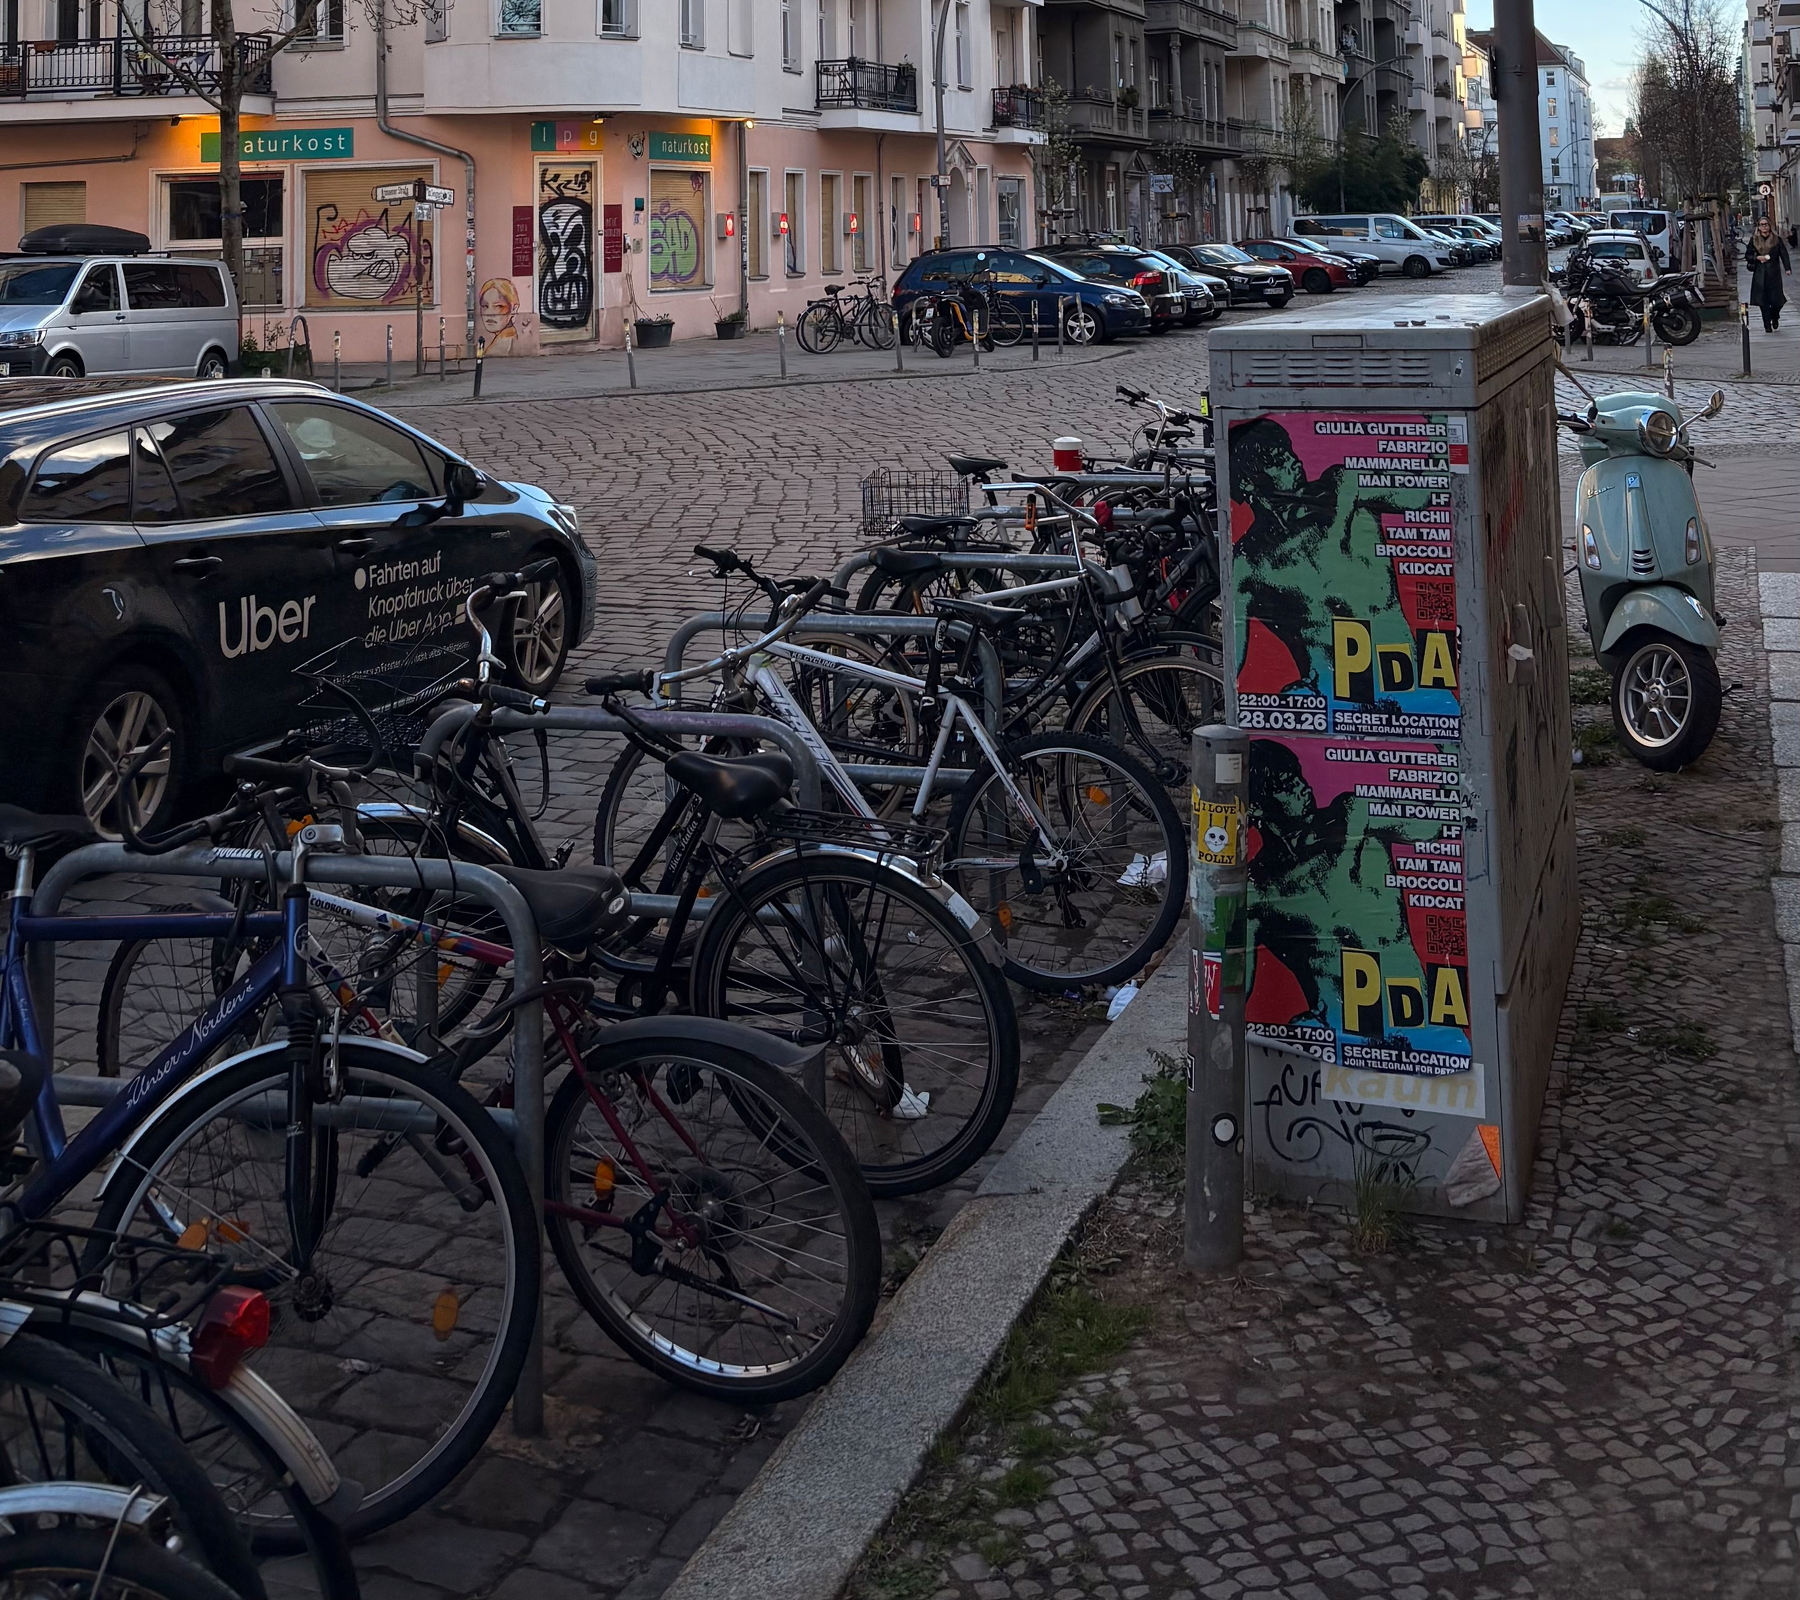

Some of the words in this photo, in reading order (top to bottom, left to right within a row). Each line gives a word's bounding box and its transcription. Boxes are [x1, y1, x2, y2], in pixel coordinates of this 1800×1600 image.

[238, 133, 347, 154] aturkost
[564, 129, 572, 145] p
[589, 129, 598, 145] g
[662, 139, 709, 155] naturkost
[1315, 422, 1365, 435] GIULIA
[1368, 423, 1446, 436] GUTTERER
[1378, 441, 1447, 454] FABRIZIO
[1345, 458, 1448, 471] MAMMARELLA
[1359, 476, 1391, 486] MAN
[1396, 476, 1448, 488] POWER
[1432, 495, 1449, 506] I-F
[1404, 512, 1450, 523] RICHII
[1387, 528, 1418, 539] TAM
[1421, 529, 1450, 540] TAM
[1376, 545, 1451, 558] BROCCOLI
[369, 559, 418, 588] Fahrten
[422, 551, 443, 577] auf
[1399, 563, 1452, 575] KIDCAT
[367, 582, 444, 618] Knopfdruck
[446, 577, 474, 599] über
[218, 595, 317, 659] Uber
[365, 626, 386, 649] die
[389, 619, 422, 642] Uber
[803, 655, 835, 669] CYCLING
[1333, 619, 1457, 699] PDA
[1240, 696, 1325, 708] 22:00-17:00
[1240, 712, 1327, 729] 28.03.26
[1335, 713, 1388, 724] SECRET
[1393, 715, 1459, 728] LOCATION
[1357, 725, 1403, 734] TELEGRAM
[1405, 727, 1423, 735] FOR
[1424, 727, 1459, 737] DETAILS
[1326, 748, 1375, 761] GIULIA
[1378, 751, 1457, 765] GUTTERER
[1390, 770, 1458, 783] FABRIZIO
[1356, 786, 1459, 801] MAMMARELLA
[1209, 805, 1236, 813] LOVE
[1370, 804, 1403, 817] MAN
[1406, 805, 1459, 820] POWER
[1442, 825, 1460, 837] I-F
[1415, 842, 1460, 855] RICHII
[1198, 851, 1234, 864] POLLY
[1397, 858, 1428, 870] TAM
[1431, 859, 1461, 873] TAM
[1386, 875, 1461, 891] BROCCOLI
[310, 898, 352, 917] COLDROCK
[1409, 894, 1463, 909] KIDCAT
[1342, 951, 1469, 1032] PDA
[1344, 1047, 1398, 1060] SECRET
[1402, 1052, 1469, 1068] LOCATION
[1345, 1060, 1364, 1068] JOIN
[1366, 1060, 1413, 1071] TELEGRAM
[1415, 1065, 1433, 1073] FOR
